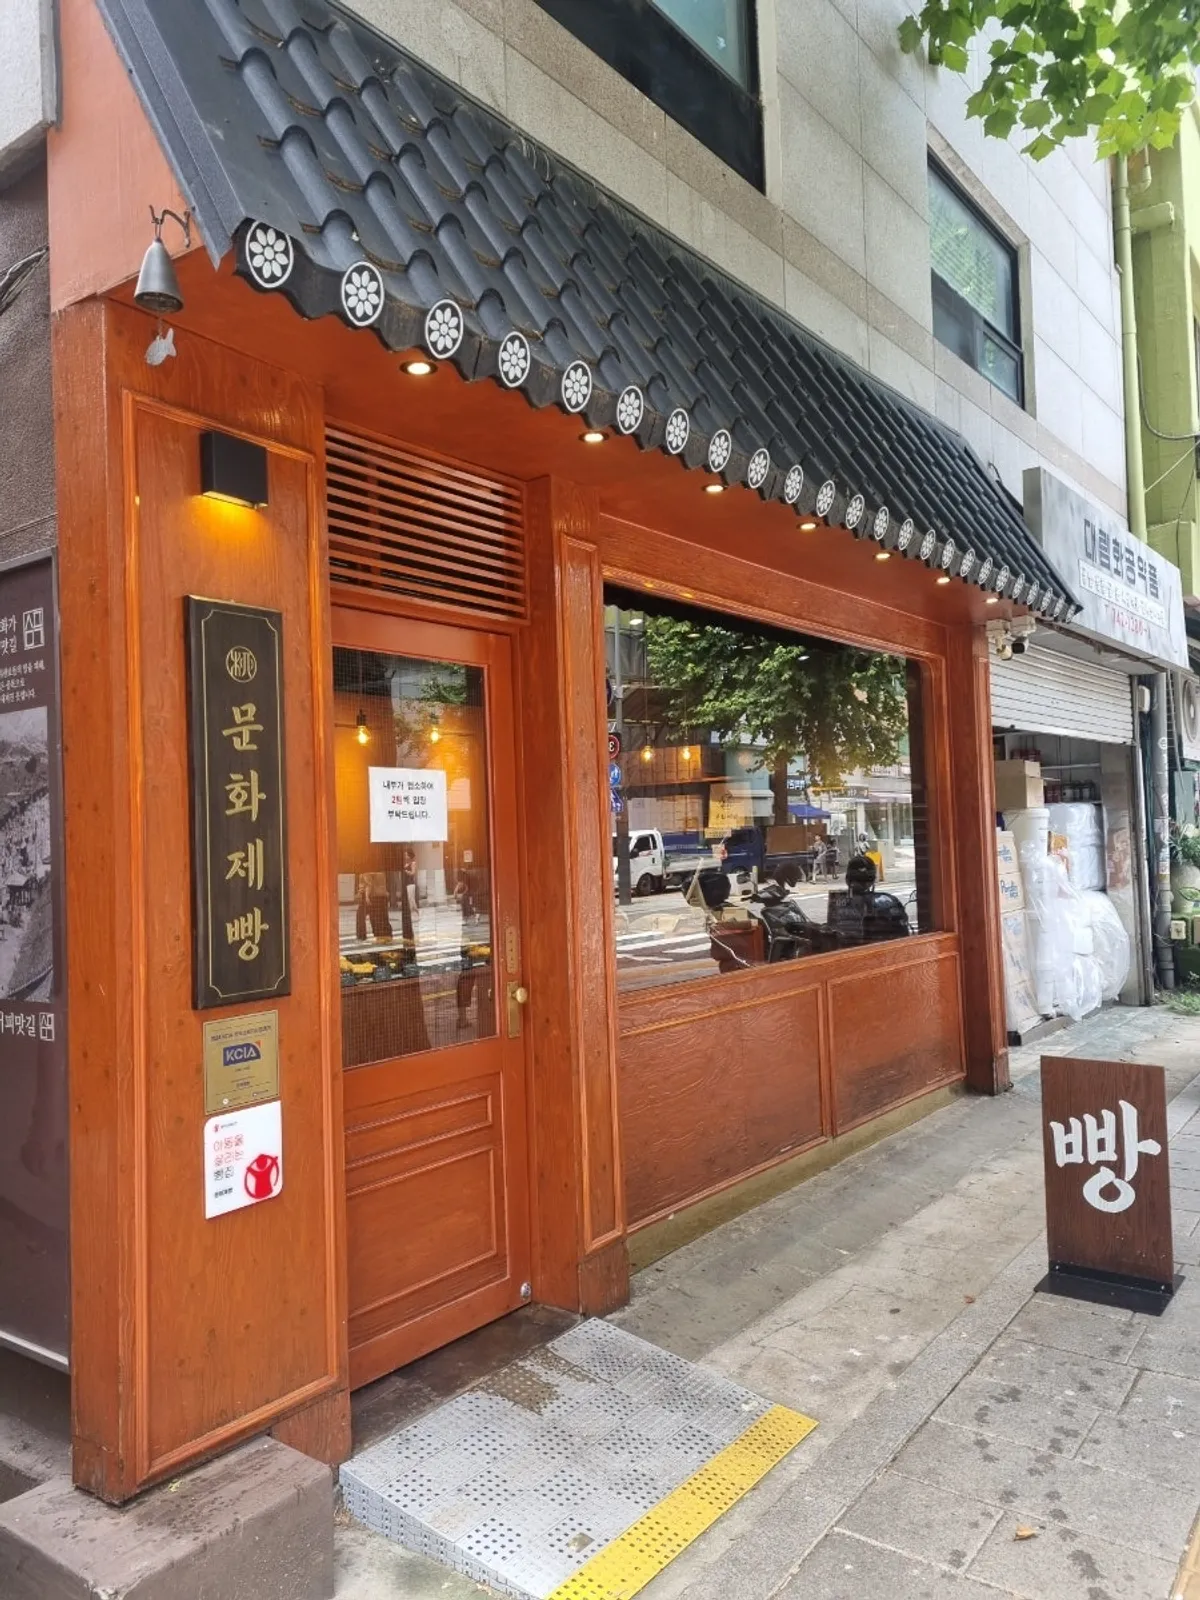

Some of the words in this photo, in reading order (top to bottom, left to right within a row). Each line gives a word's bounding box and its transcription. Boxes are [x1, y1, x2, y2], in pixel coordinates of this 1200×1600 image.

[222, 702, 269, 961] 문화제빵
[225, 1046, 257, 1062] KCIA
[1049, 1099, 1162, 1214] 빵
